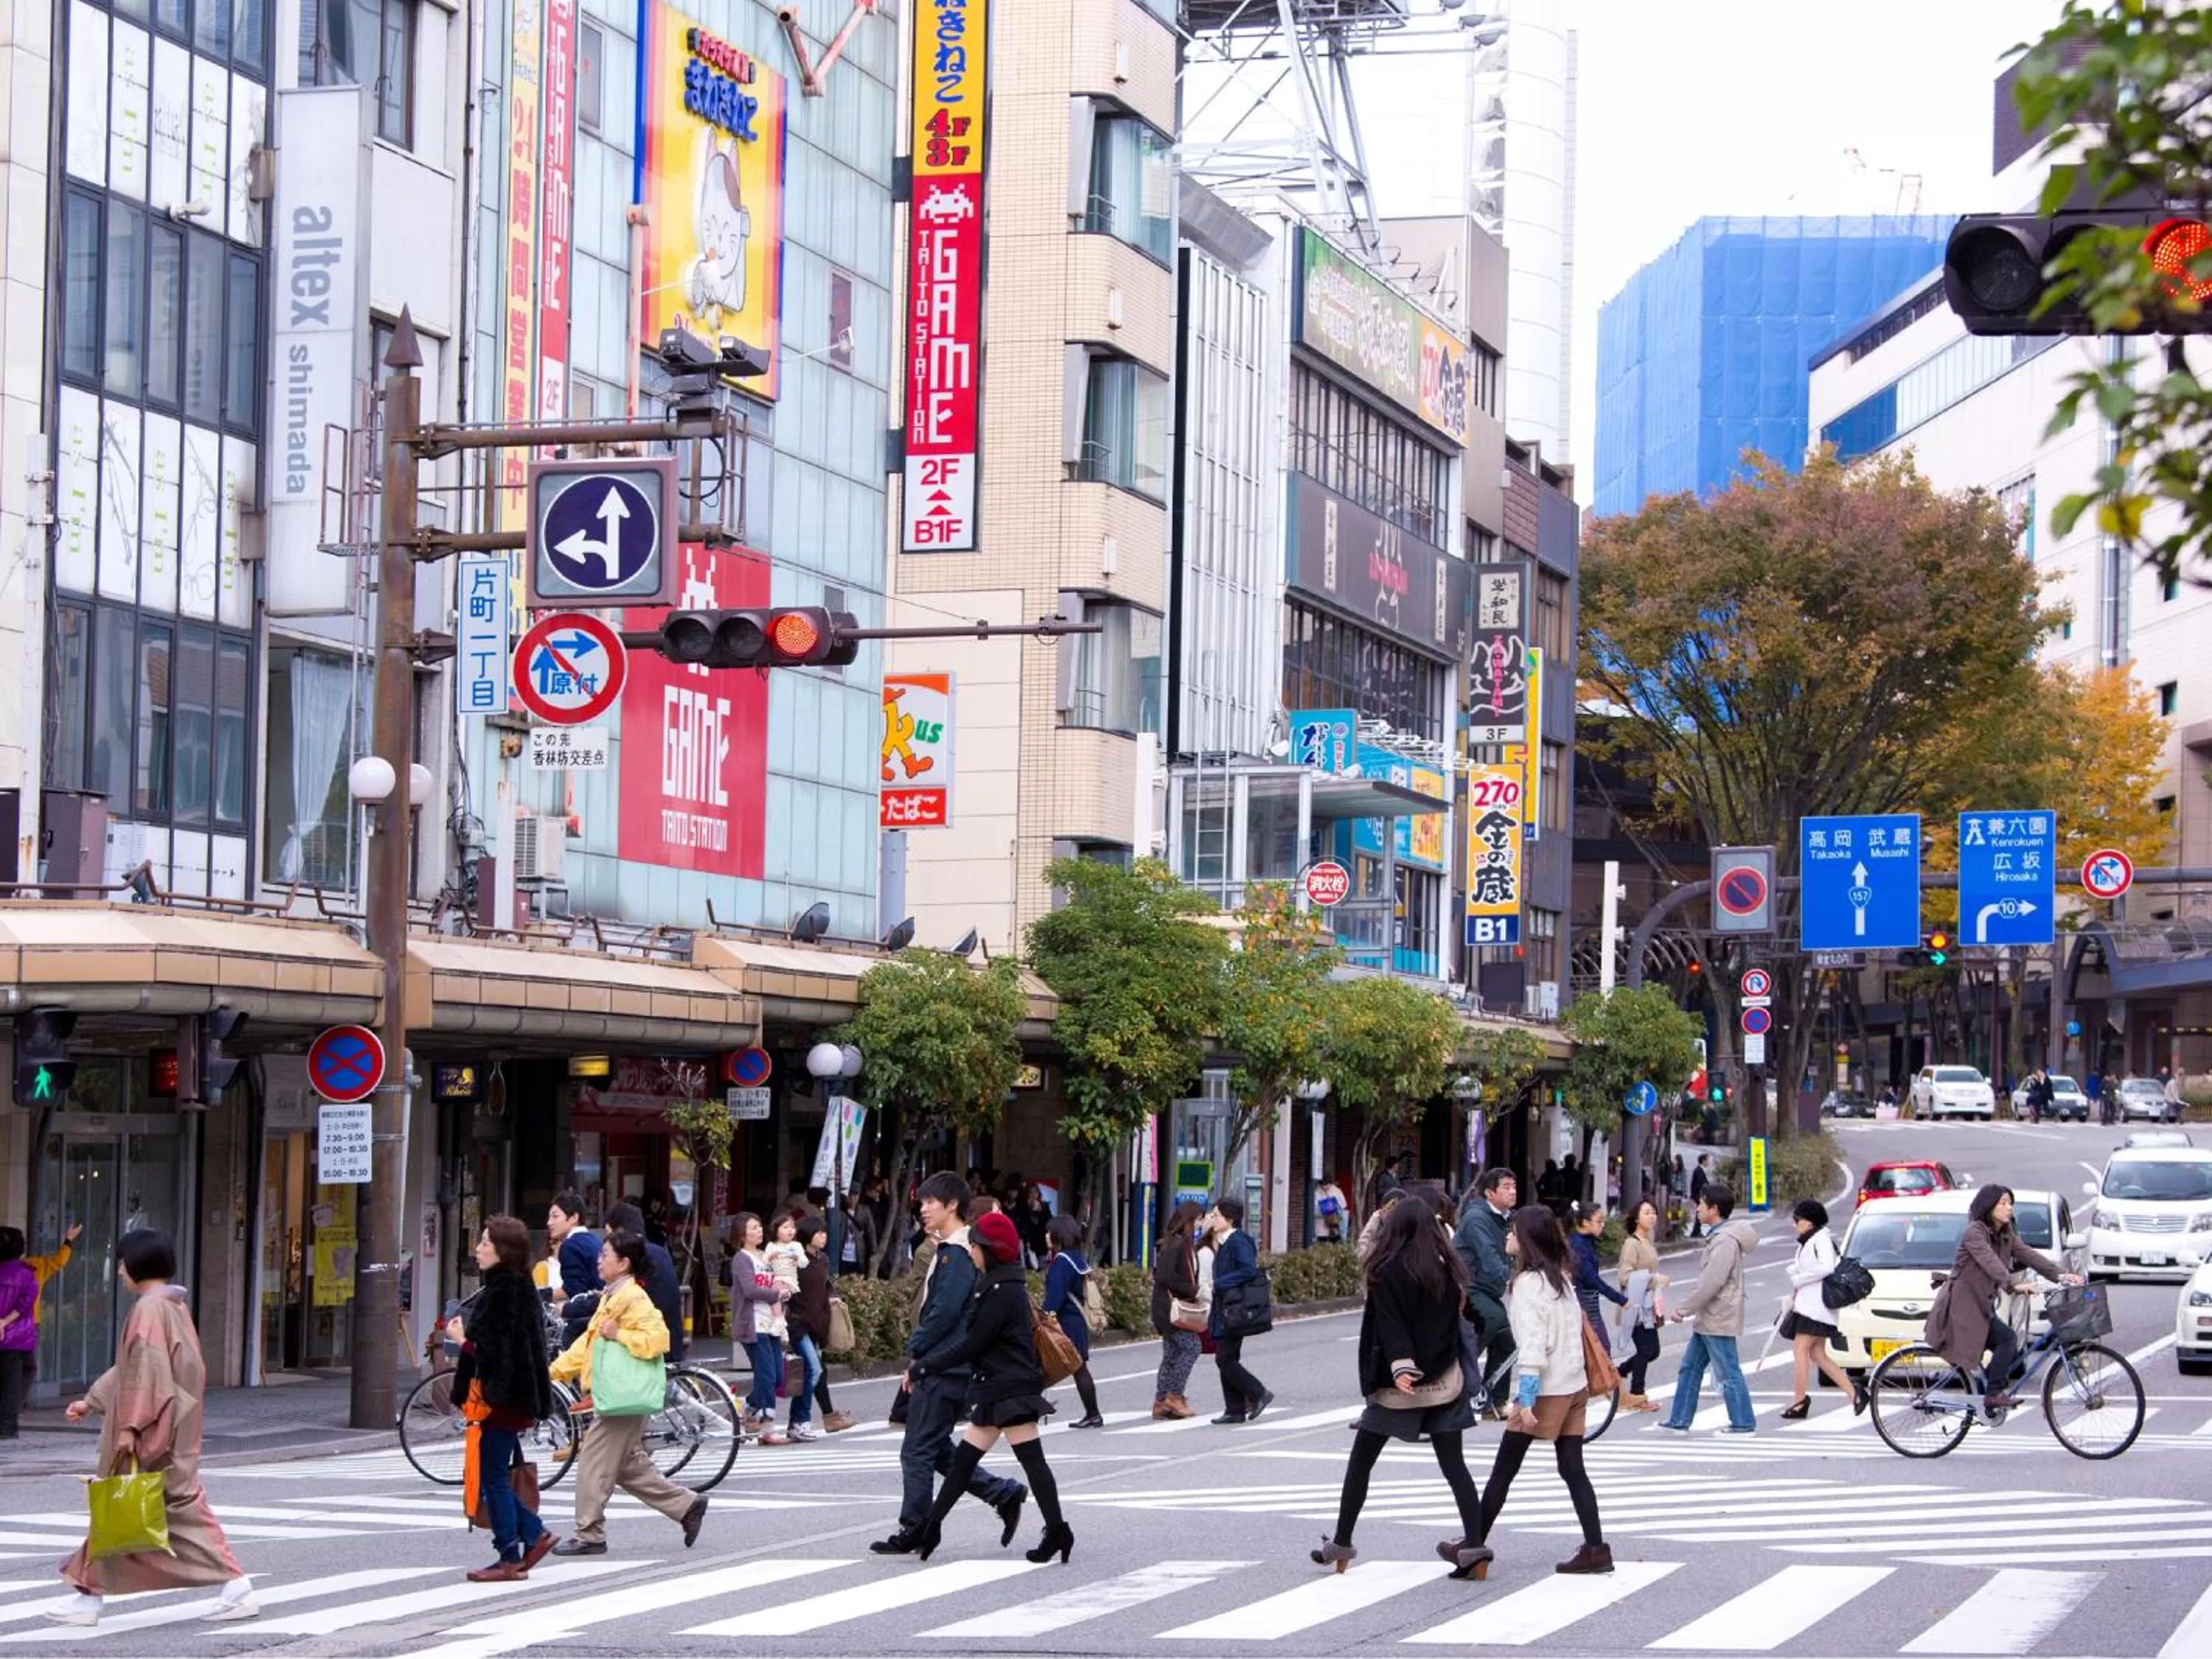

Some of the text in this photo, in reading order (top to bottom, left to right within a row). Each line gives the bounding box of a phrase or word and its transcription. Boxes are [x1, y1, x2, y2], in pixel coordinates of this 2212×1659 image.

[933, 0, 967, 103] きねこ
[684, 58, 758, 142] まねきねこ
[925, 108, 972, 138] 4F
[925, 138, 970, 167] 3F
[913, 229, 930, 445] TAITO STATION
[929, 229, 970, 444] GAME
[285, 205, 343, 495] altex shimada
[920, 457, 960, 487] 2F
[914, 518, 963, 545] B1F
[470, 568, 497, 706] 片町一丁目
[549, 672, 599, 695] 原付
[533, 734, 571, 747] この先
[661, 684, 731, 807] GAME
[1486, 728, 1508, 740] 3F
[532, 750, 605, 767] 香林坊交差点
[1474, 780, 1520, 807] 270
[661, 809, 728, 852] TAITO STATION
[1809, 827, 1912, 848] 高岡 武蔵
[1987, 816, 2048, 836] 兼六園
[1810, 847, 1910, 860] Takaoka Musashi
[1992, 838, 2044, 847] Kenrokuen
[1471, 810, 1517, 904] 金の蔵
[1994, 851, 2042, 870] 広坂
[1309, 874, 1346, 892] 消火栓
[1995, 872, 2039, 882] Hirosaka
[1852, 891, 1869, 902] 157
[2001, 902, 2016, 914] 10
[1475, 918, 1508, 942] B1
